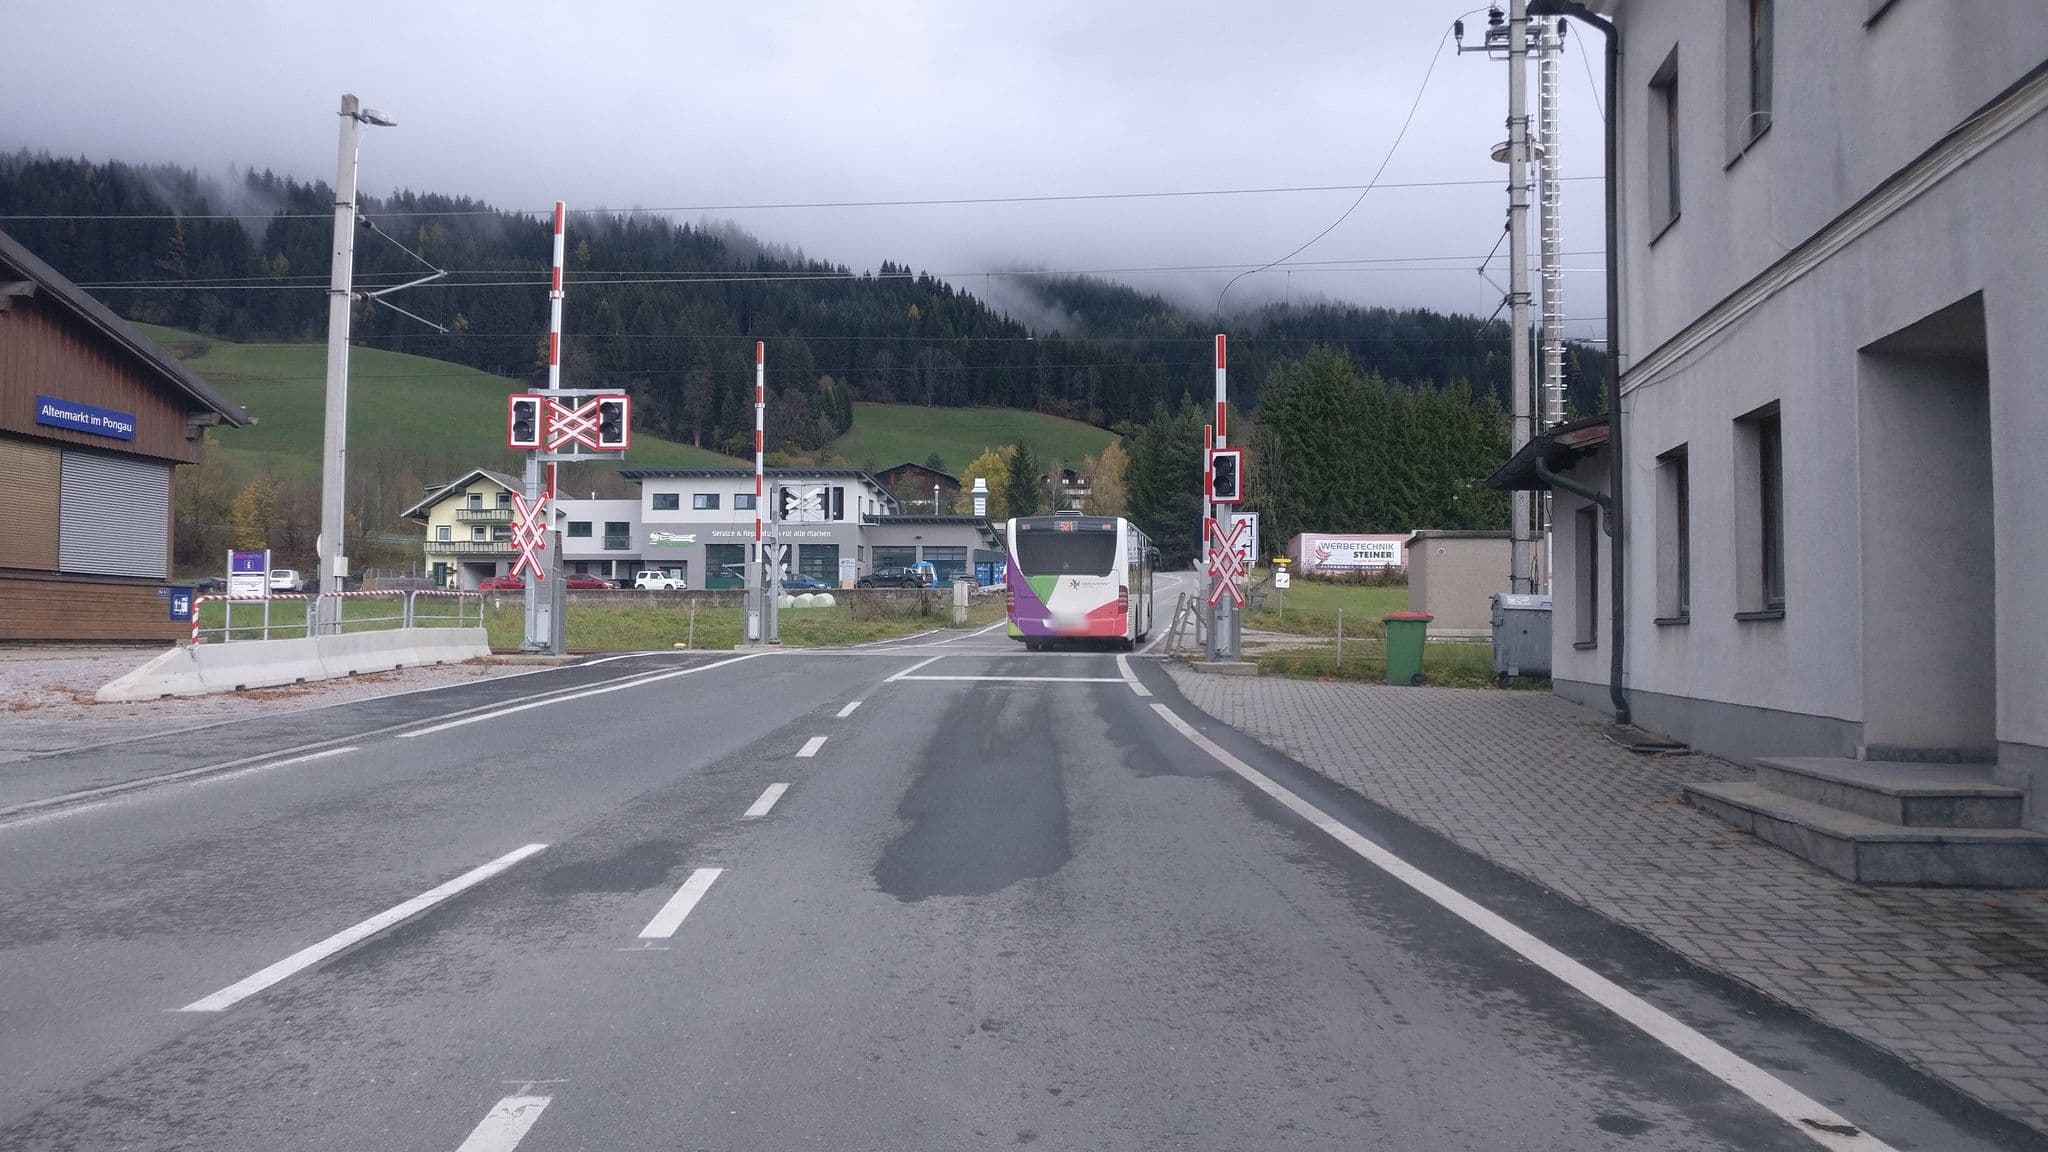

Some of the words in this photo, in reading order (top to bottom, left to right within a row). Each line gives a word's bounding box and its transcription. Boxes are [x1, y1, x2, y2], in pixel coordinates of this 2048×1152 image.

[41, 405, 89, 424] Altenmarkt
[91, 414, 101, 426] im
[102, 416, 132, 433] Pongau
[793, 529, 806, 537] alle
[807, 529, 832, 537] Marken
[1320, 542, 1395, 551] WERBETECHNIK
[1353, 551, 1392, 559] STEINER
